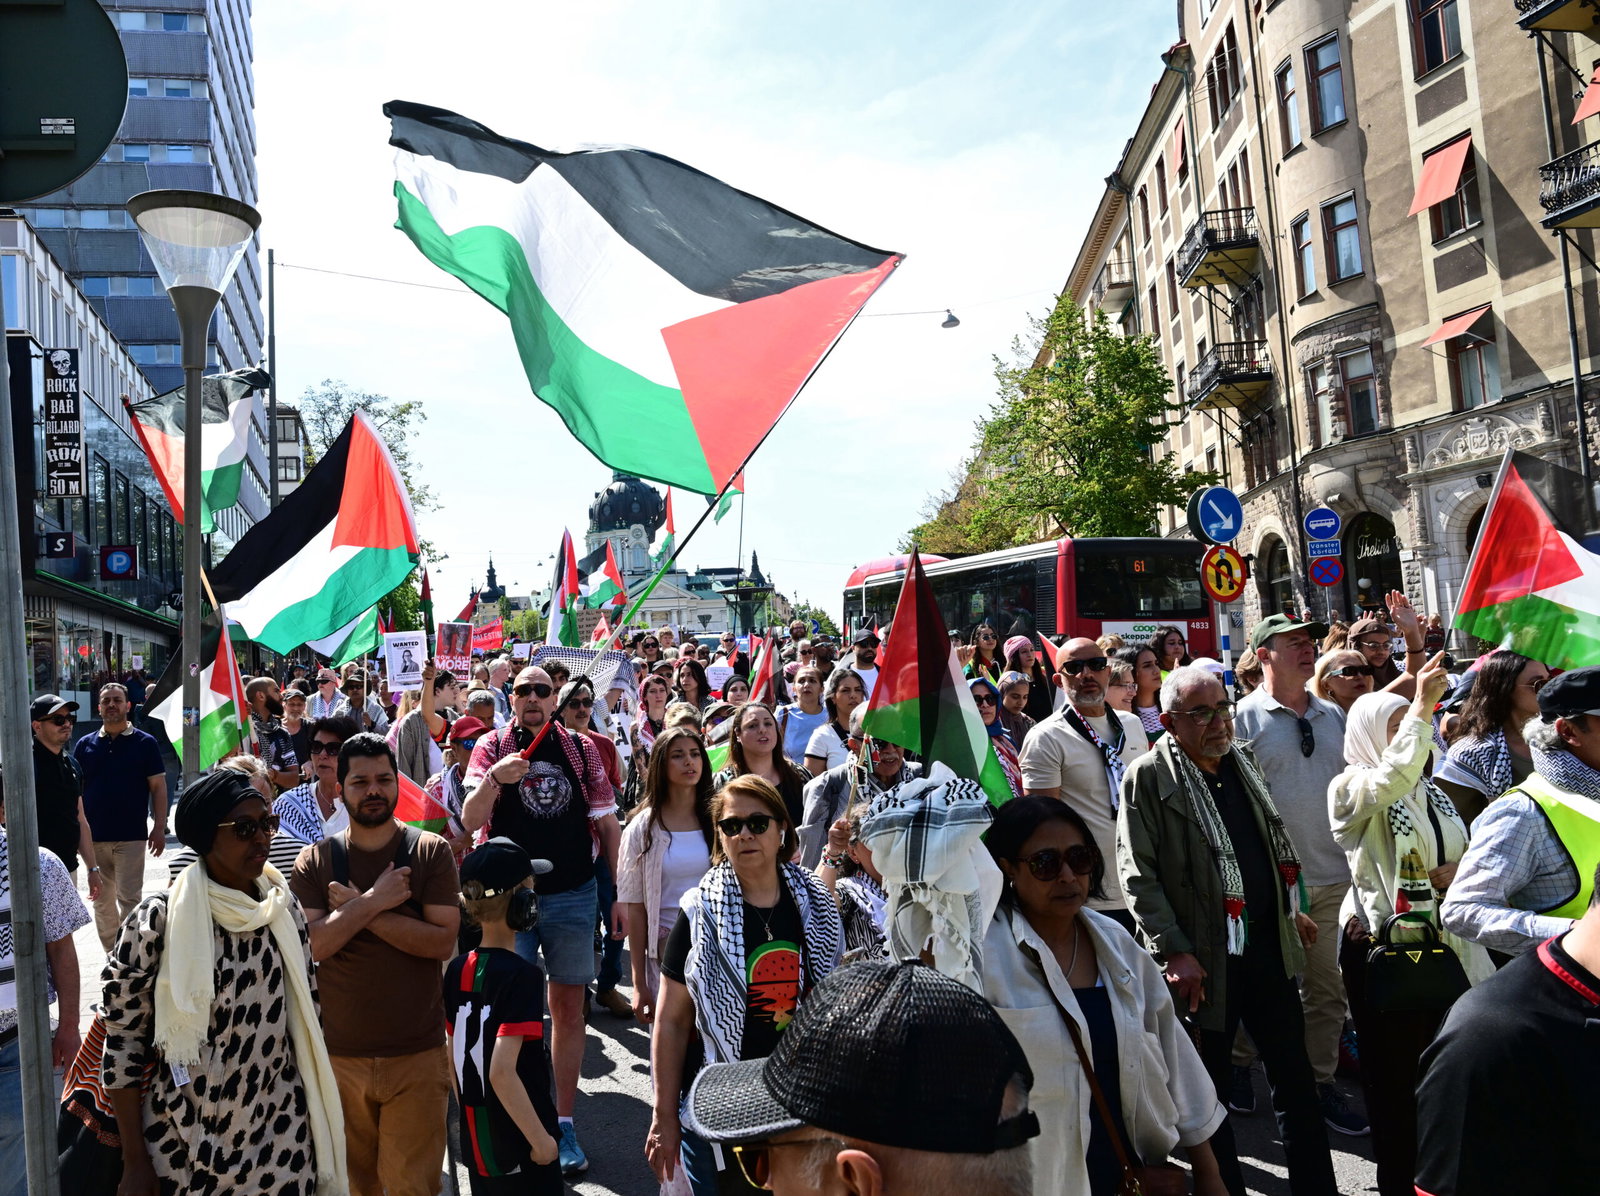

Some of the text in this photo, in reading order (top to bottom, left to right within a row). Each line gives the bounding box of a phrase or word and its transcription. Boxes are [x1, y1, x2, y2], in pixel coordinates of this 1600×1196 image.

[46, 378, 77, 393] ROCK
[50, 399, 75, 414] BAR
[46, 420, 80, 434] BILJARD
[50, 478, 80, 495] 50 M
[1134, 560, 1145, 572] 61
[1132, 625, 1157, 633] coop
[1120, 632, 1153, 640] skeppar
[435, 660, 469, 671] MORE
